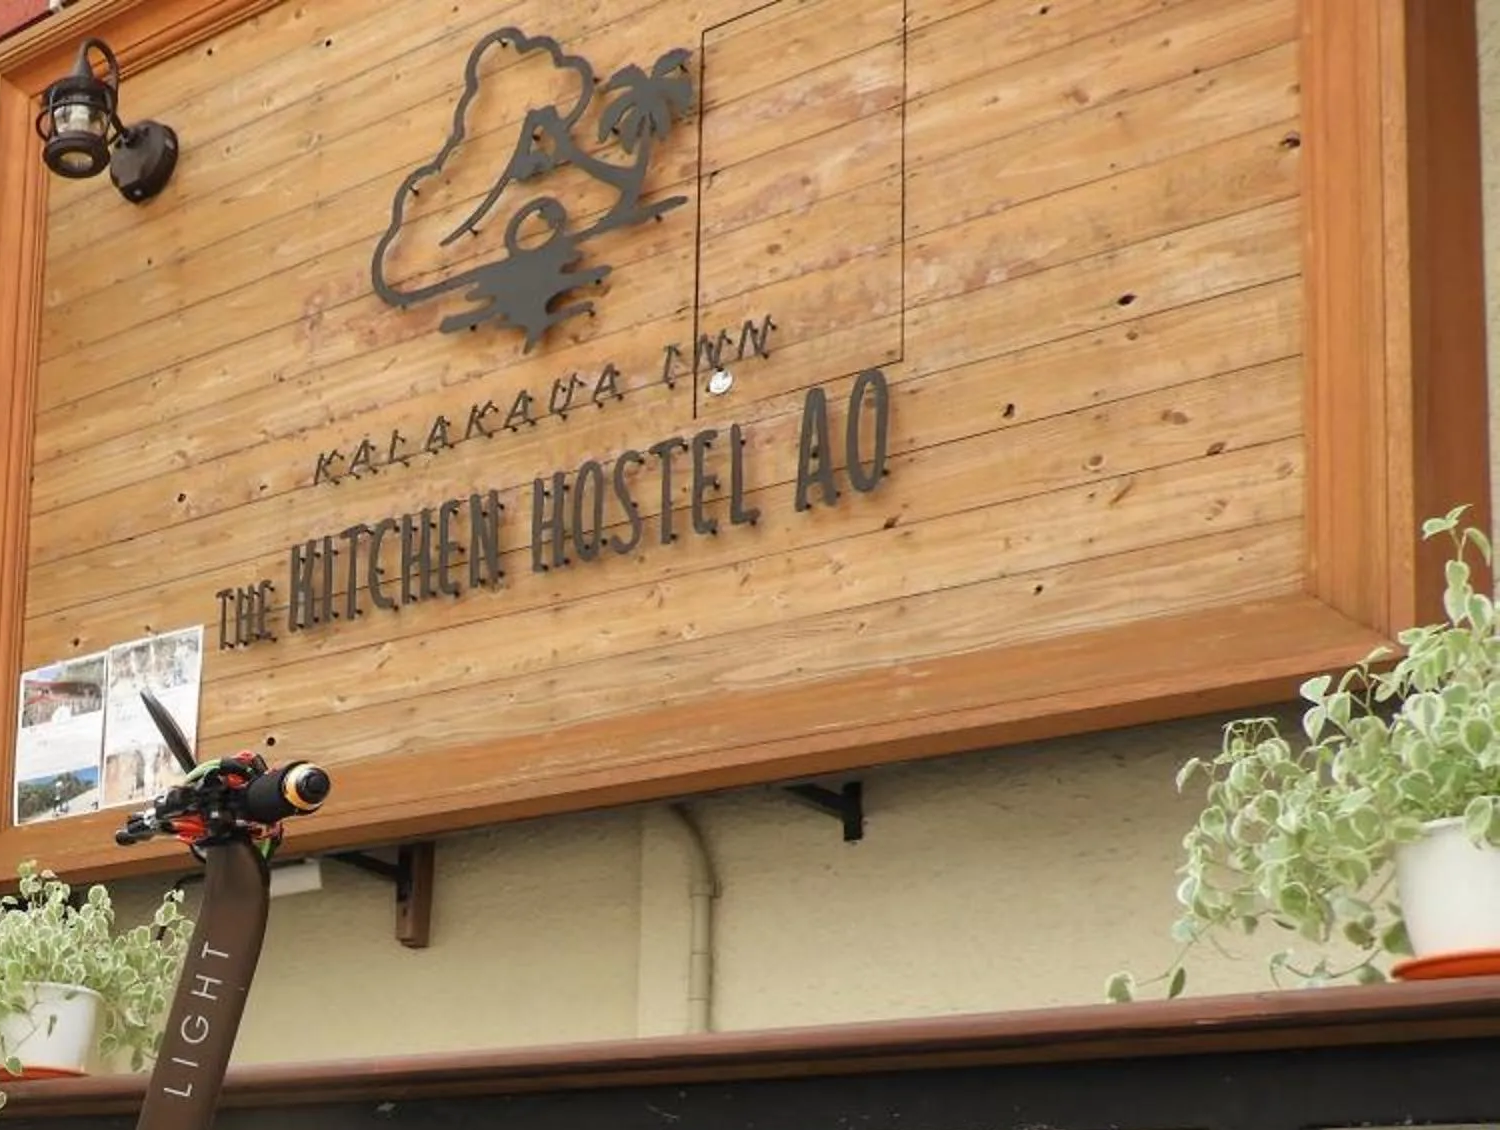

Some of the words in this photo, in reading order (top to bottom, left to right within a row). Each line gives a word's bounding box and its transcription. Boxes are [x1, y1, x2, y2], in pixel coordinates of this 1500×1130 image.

[314, 363, 623, 485] KALAKAUA
[663, 314, 777, 388] INN
[216, 579, 277, 650] THE
[288, 489, 501, 632] KITCHEN
[531, 423, 761, 573] HOSTEL
[795, 368, 890, 512] AO
[163, 941, 229, 1097] LIGHT
